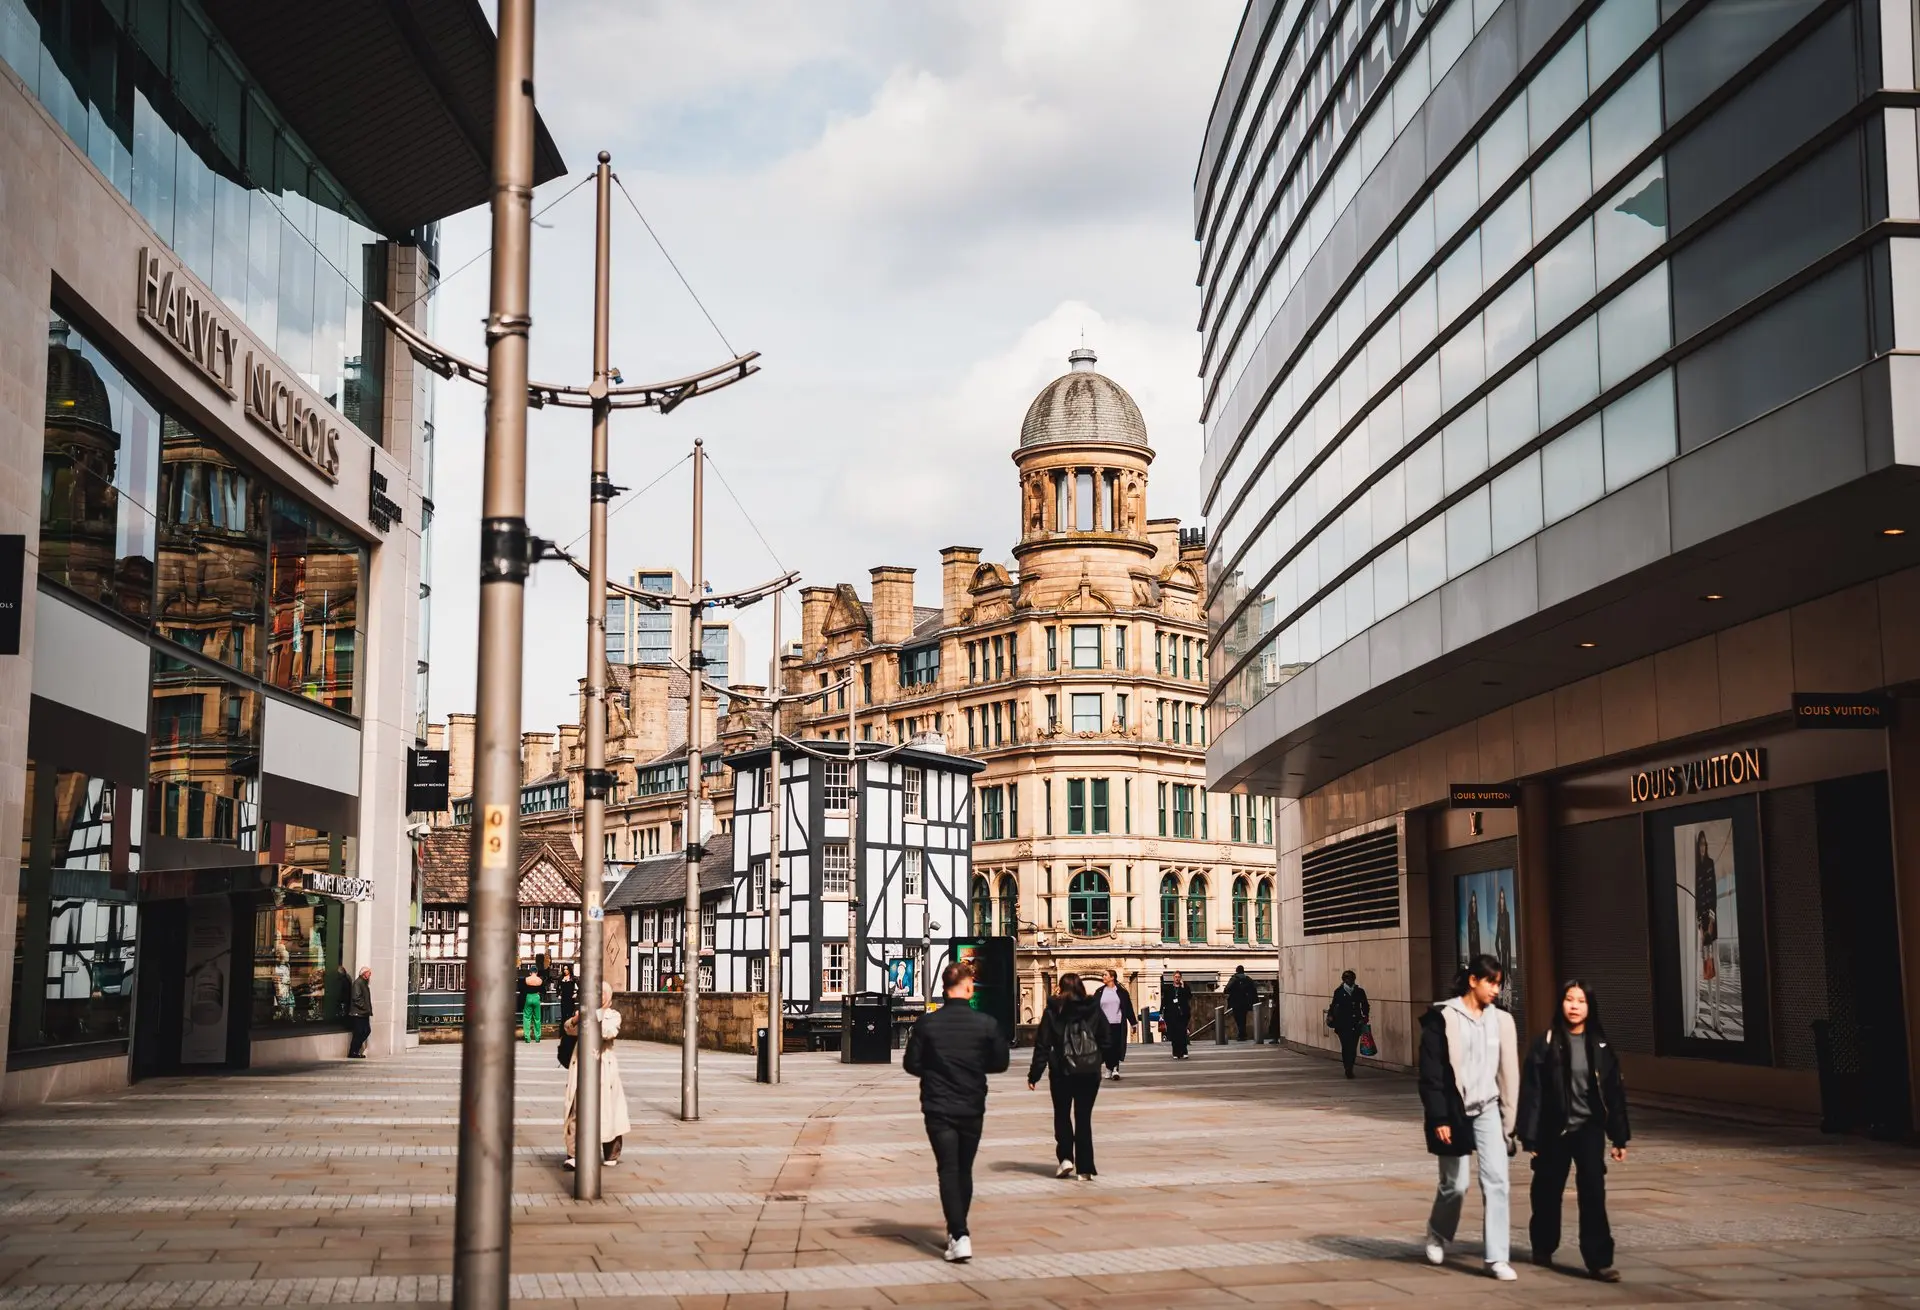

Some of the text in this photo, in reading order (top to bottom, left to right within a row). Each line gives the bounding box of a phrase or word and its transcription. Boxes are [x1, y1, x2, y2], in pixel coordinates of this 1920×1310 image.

[139, 246, 340, 477] HARVEY NICHOLS
[1800, 706, 1880, 716] LOUIS VUITTON
[1630, 748, 1761, 803] LOUIS VUITTON
[1453, 792, 1511, 800] LOUIS VUITTON
[313, 873, 335, 893] HARVEY
